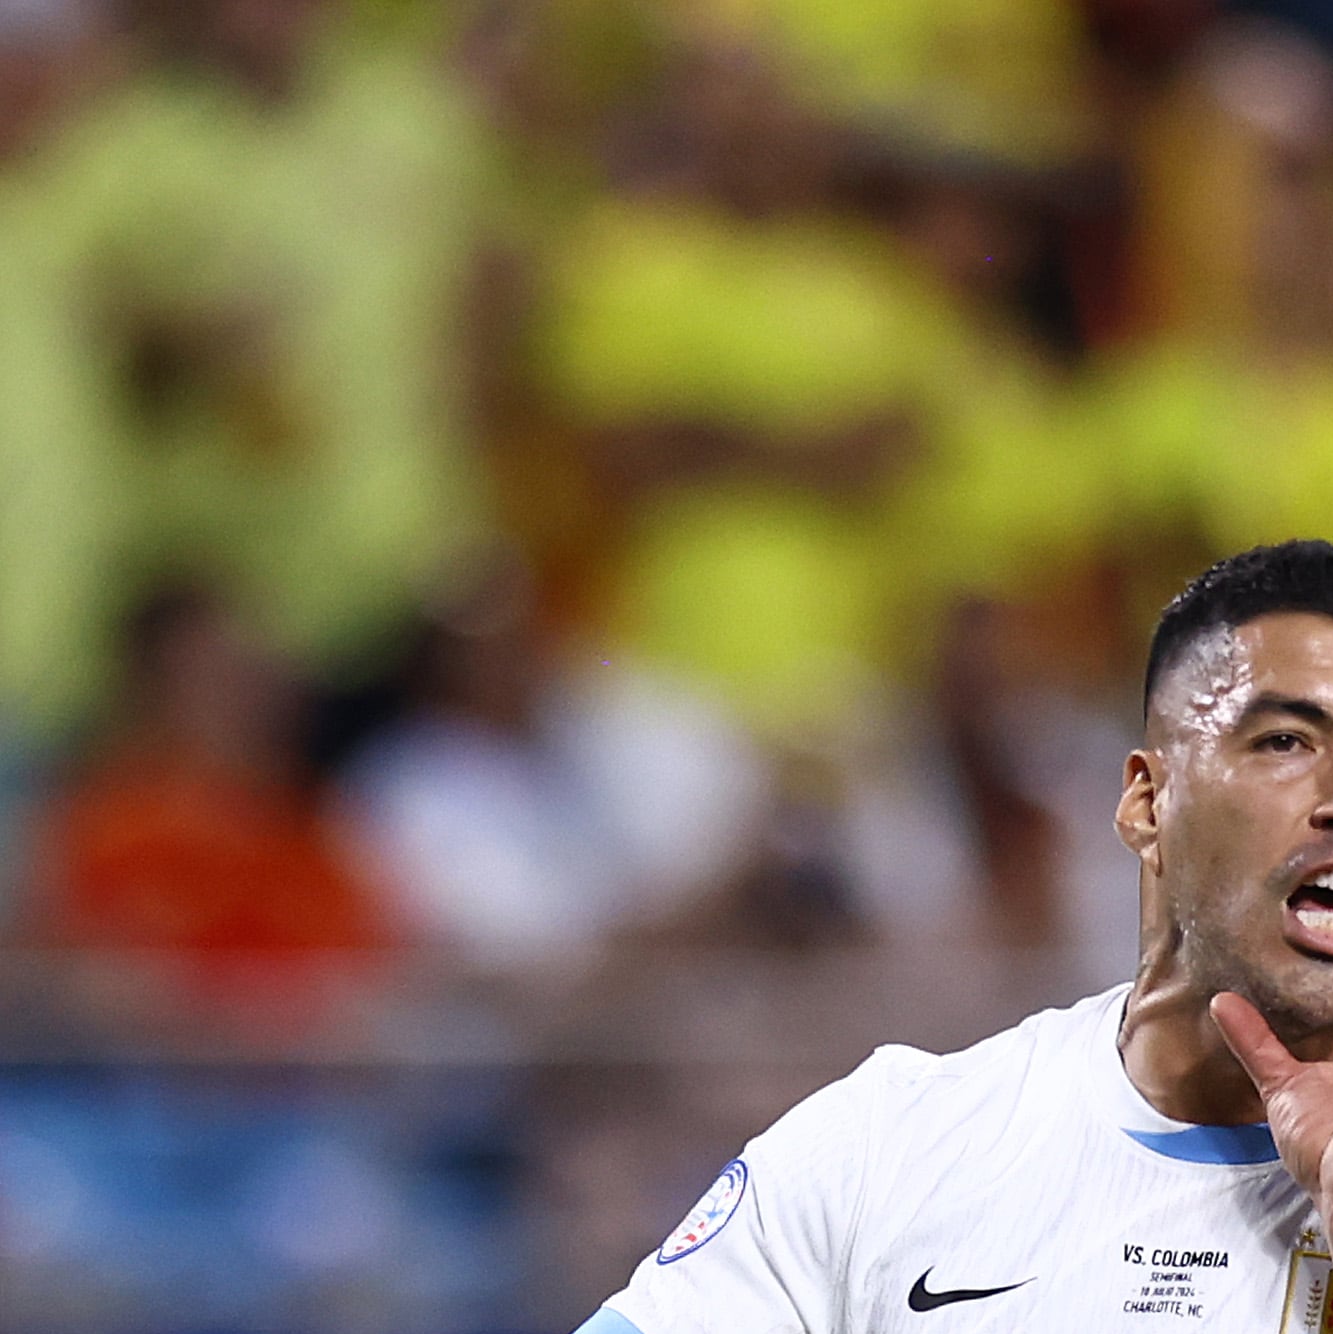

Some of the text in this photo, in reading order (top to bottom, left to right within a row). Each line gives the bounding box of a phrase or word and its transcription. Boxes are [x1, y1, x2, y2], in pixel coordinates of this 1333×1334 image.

[1123, 1243, 1229, 1268] VS. COLOMBIA
[1123, 1300, 1205, 1319] CHARLOTTE, NC
